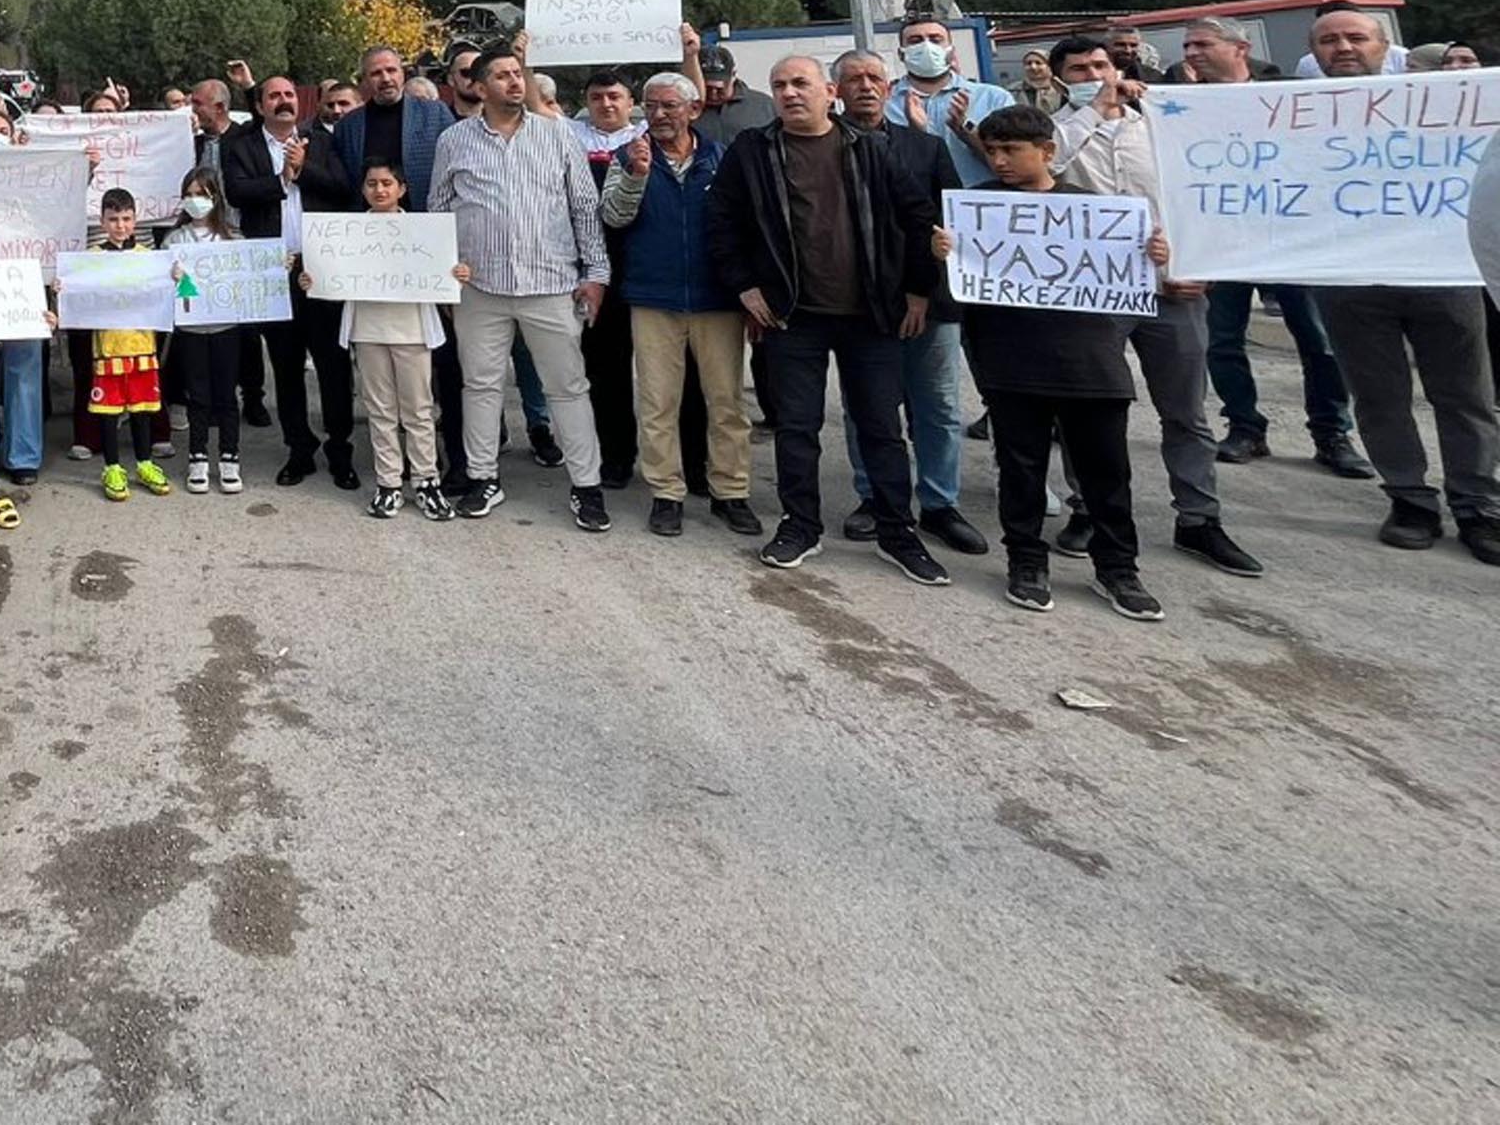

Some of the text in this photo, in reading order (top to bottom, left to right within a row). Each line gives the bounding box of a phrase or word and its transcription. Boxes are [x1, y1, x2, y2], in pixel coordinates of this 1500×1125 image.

[1259, 80, 1500, 130] YETKİLİL
[1185, 130, 1487, 174] ÇÖP SAĞLIK
[1187, 176, 1471, 219] TEMİZ ÇEVR
[320, 242, 435, 260] ALMAK
